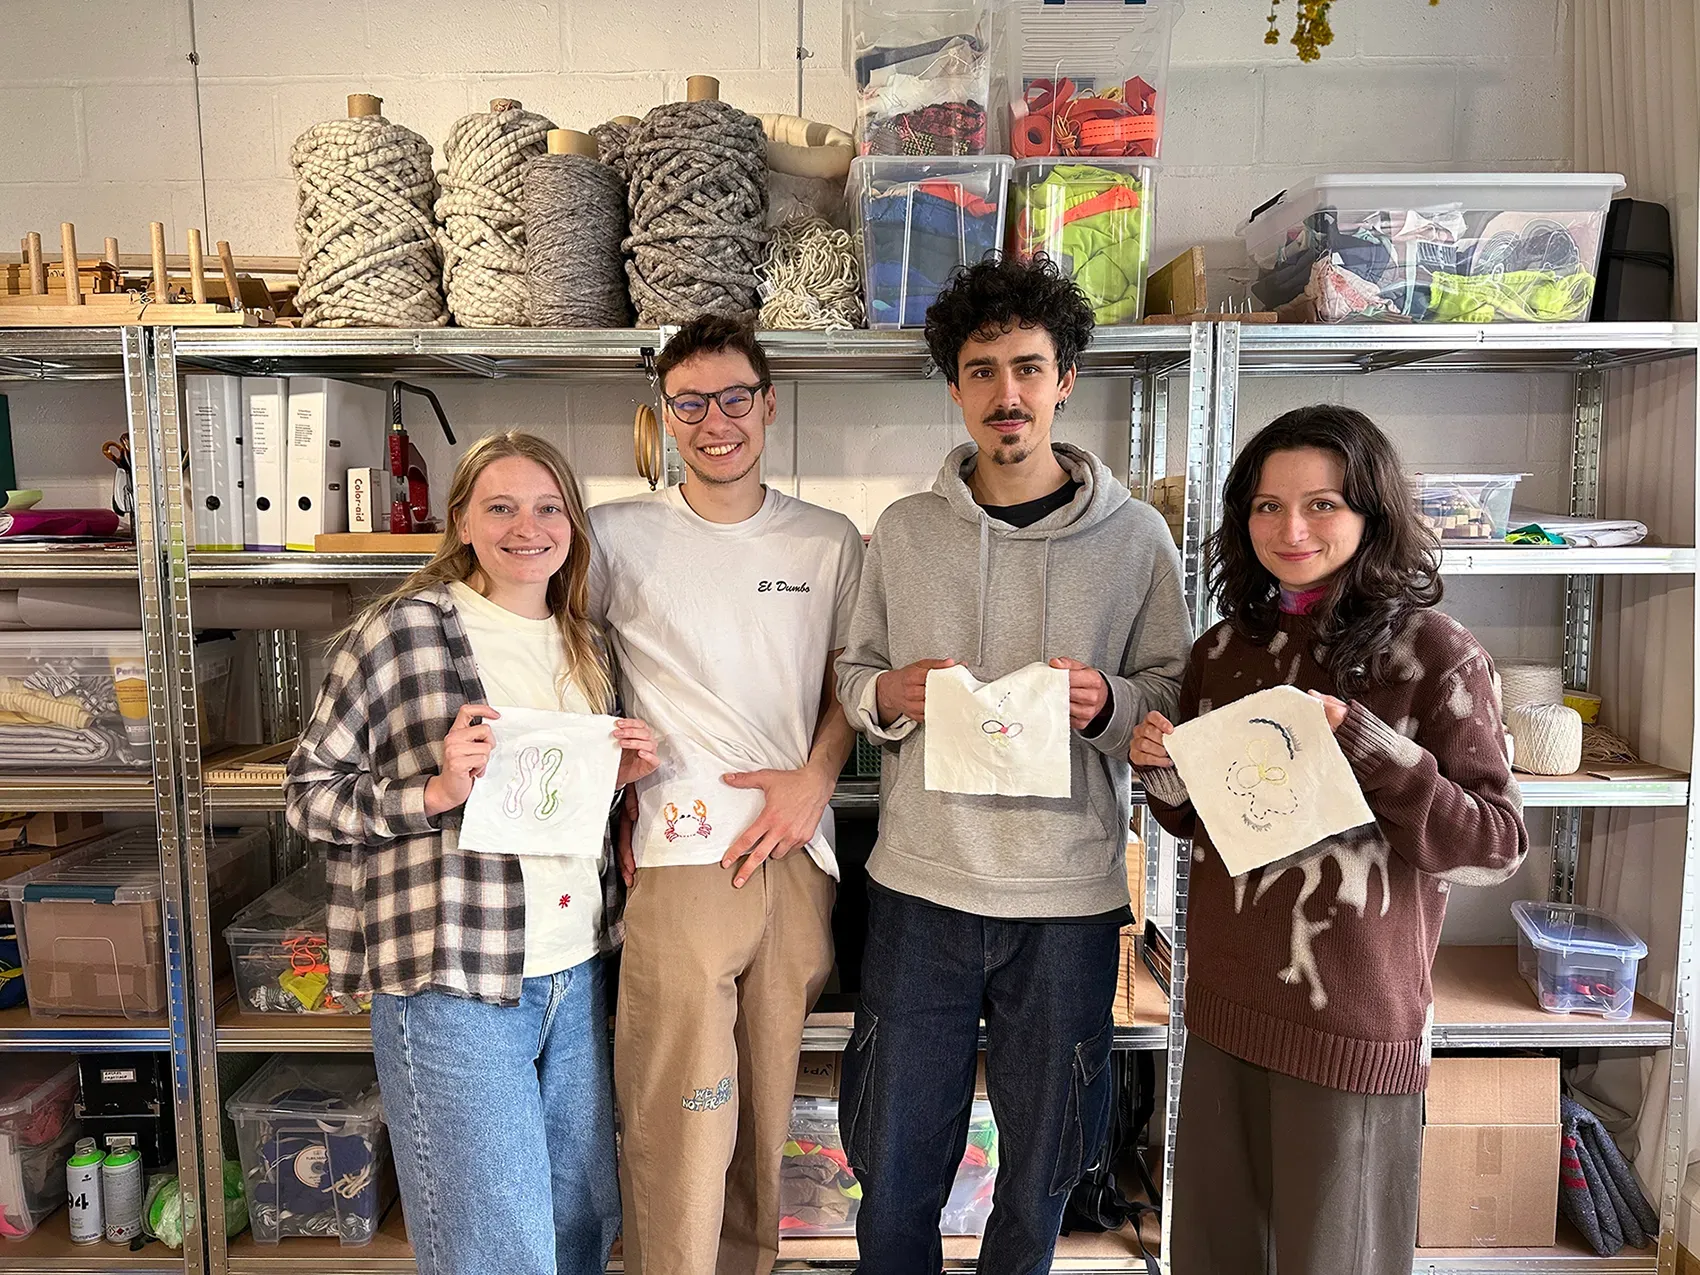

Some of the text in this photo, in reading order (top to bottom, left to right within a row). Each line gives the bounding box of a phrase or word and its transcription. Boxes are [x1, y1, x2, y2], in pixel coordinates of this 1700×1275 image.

[354, 478, 365, 522] Color-aid
[757, 580, 811, 593] El Dumbo
[694, 1087, 713, 1100] WE
[682, 1096, 704, 1111] NOT
